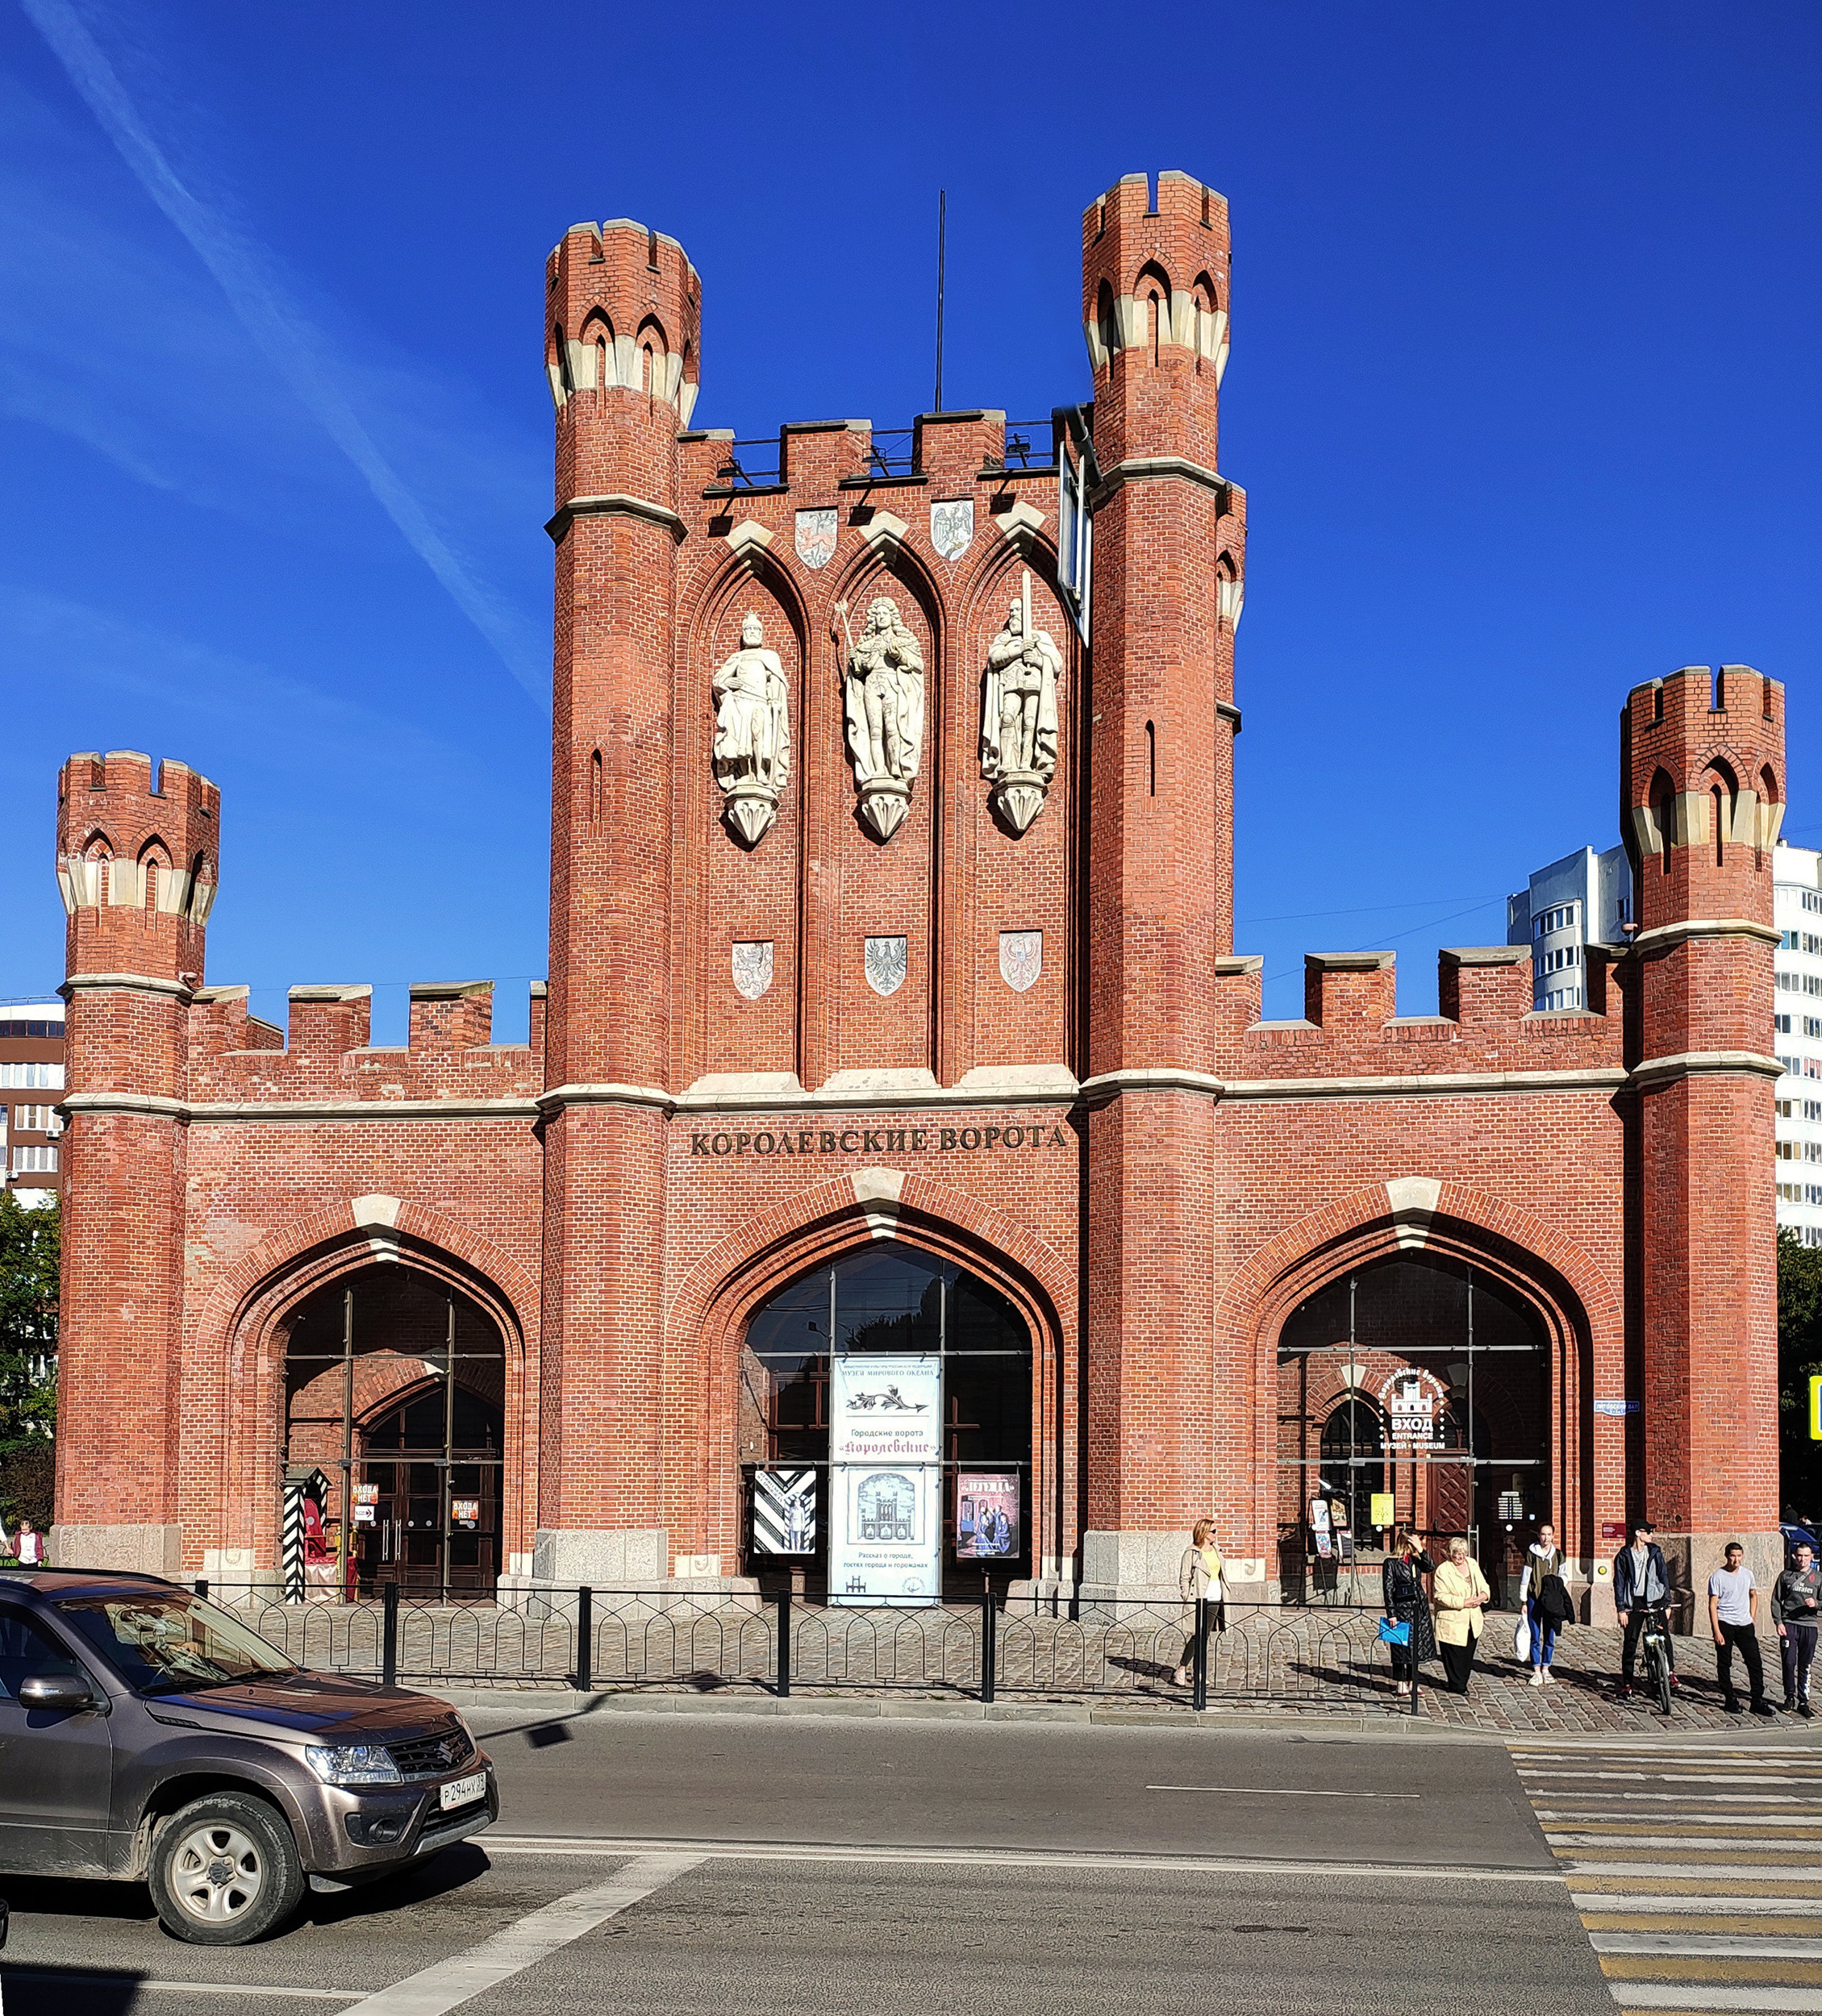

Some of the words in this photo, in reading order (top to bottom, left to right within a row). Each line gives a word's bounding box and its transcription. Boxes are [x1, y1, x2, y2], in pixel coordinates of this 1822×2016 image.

[690, 1128, 928, 1156] КОРОЛЕВСКИЕ
[939, 1125, 1067, 1151] ВОРОТА
[1391, 1418, 1434, 1432] ВХОД
[851, 1429, 893, 1438] Городские
[895, 1430, 924, 1438] ворота
[1391, 1432, 1433, 1440] ENTRANCE
[839, 1439, 936, 1456] «Королевские»
[1380, 1441, 1407, 1449] МУЗЕЙ
[1412, 1442, 1445, 1450] MUSEUM
[352, 1485, 377, 1494] ВХОДА
[357, 1493, 372, 1503] НЕТ
[452, 1502, 478, 1510] ВХОДА
[457, 1510, 472, 1519] НЕТ
